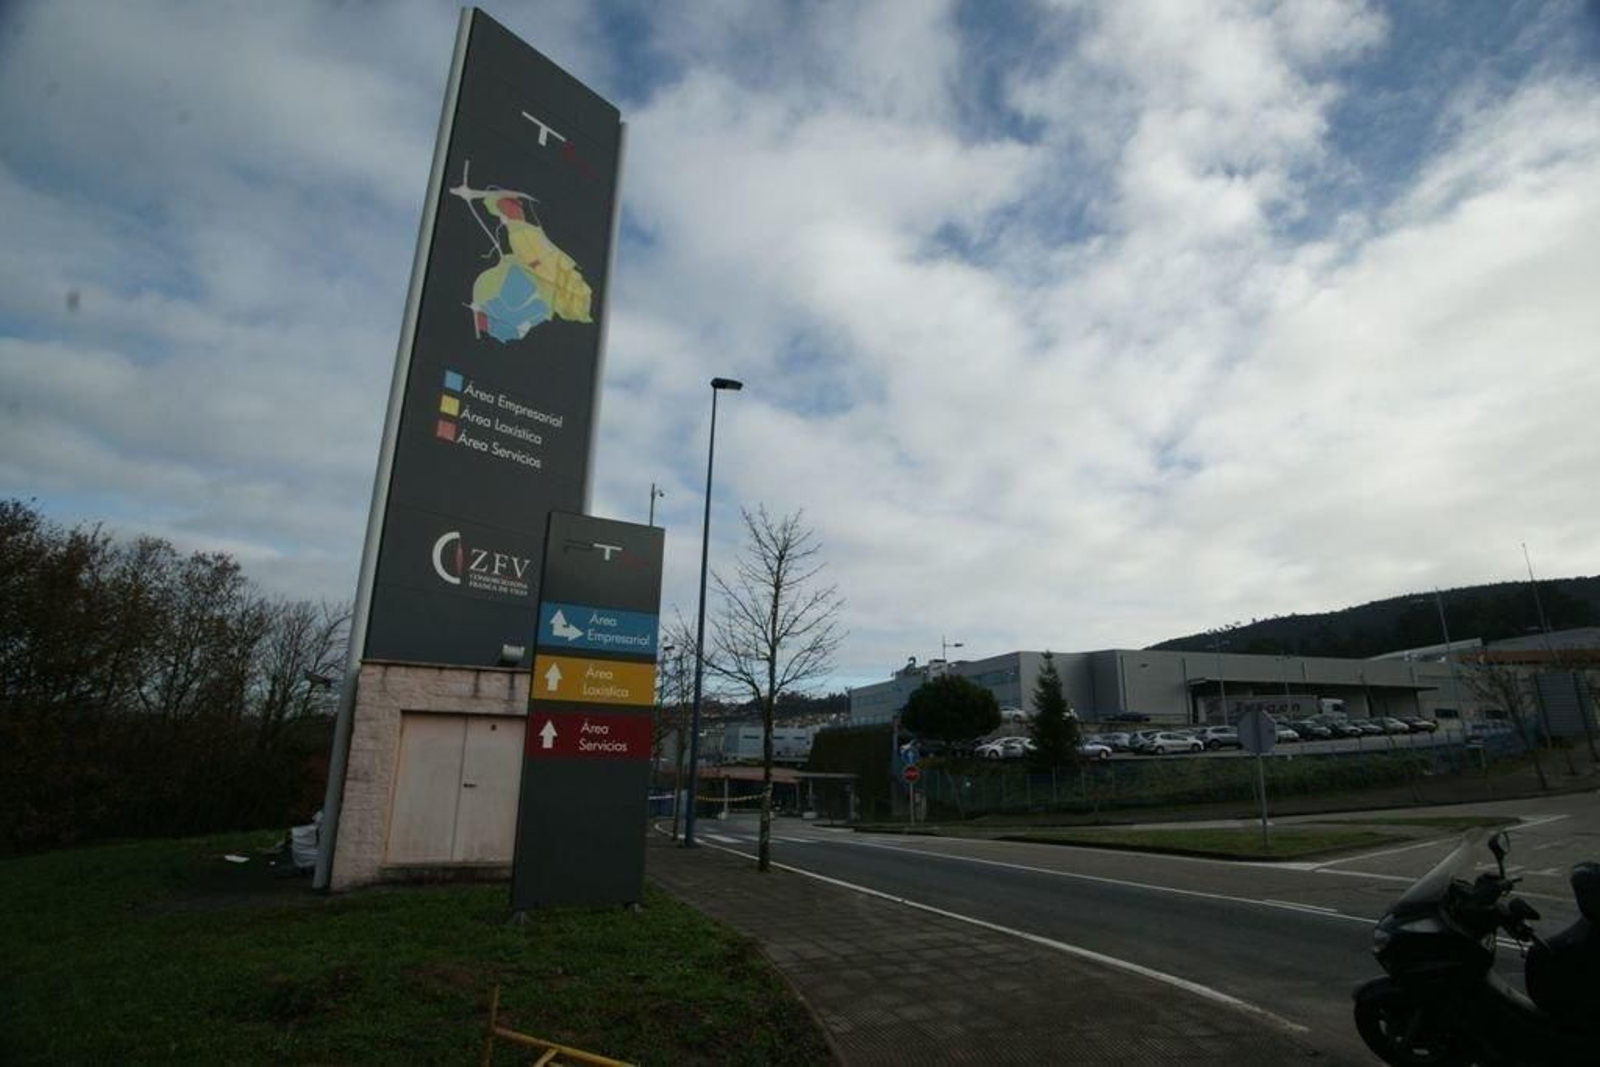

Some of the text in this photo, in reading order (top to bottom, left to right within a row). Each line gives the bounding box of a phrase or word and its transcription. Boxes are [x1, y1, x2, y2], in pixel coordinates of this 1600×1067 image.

[463, 380, 563, 428] Área Empresarial
[461, 404, 491, 427] Área
[457, 429, 542, 468] Área Servicios
[469, 548, 531, 578] ZFV
[589, 610, 617, 627] Área
[587, 628, 651, 646] Empresarial
[585, 664, 613, 680] Área
[580, 718, 609, 735] Área
[579, 738, 628, 752] Servicios
